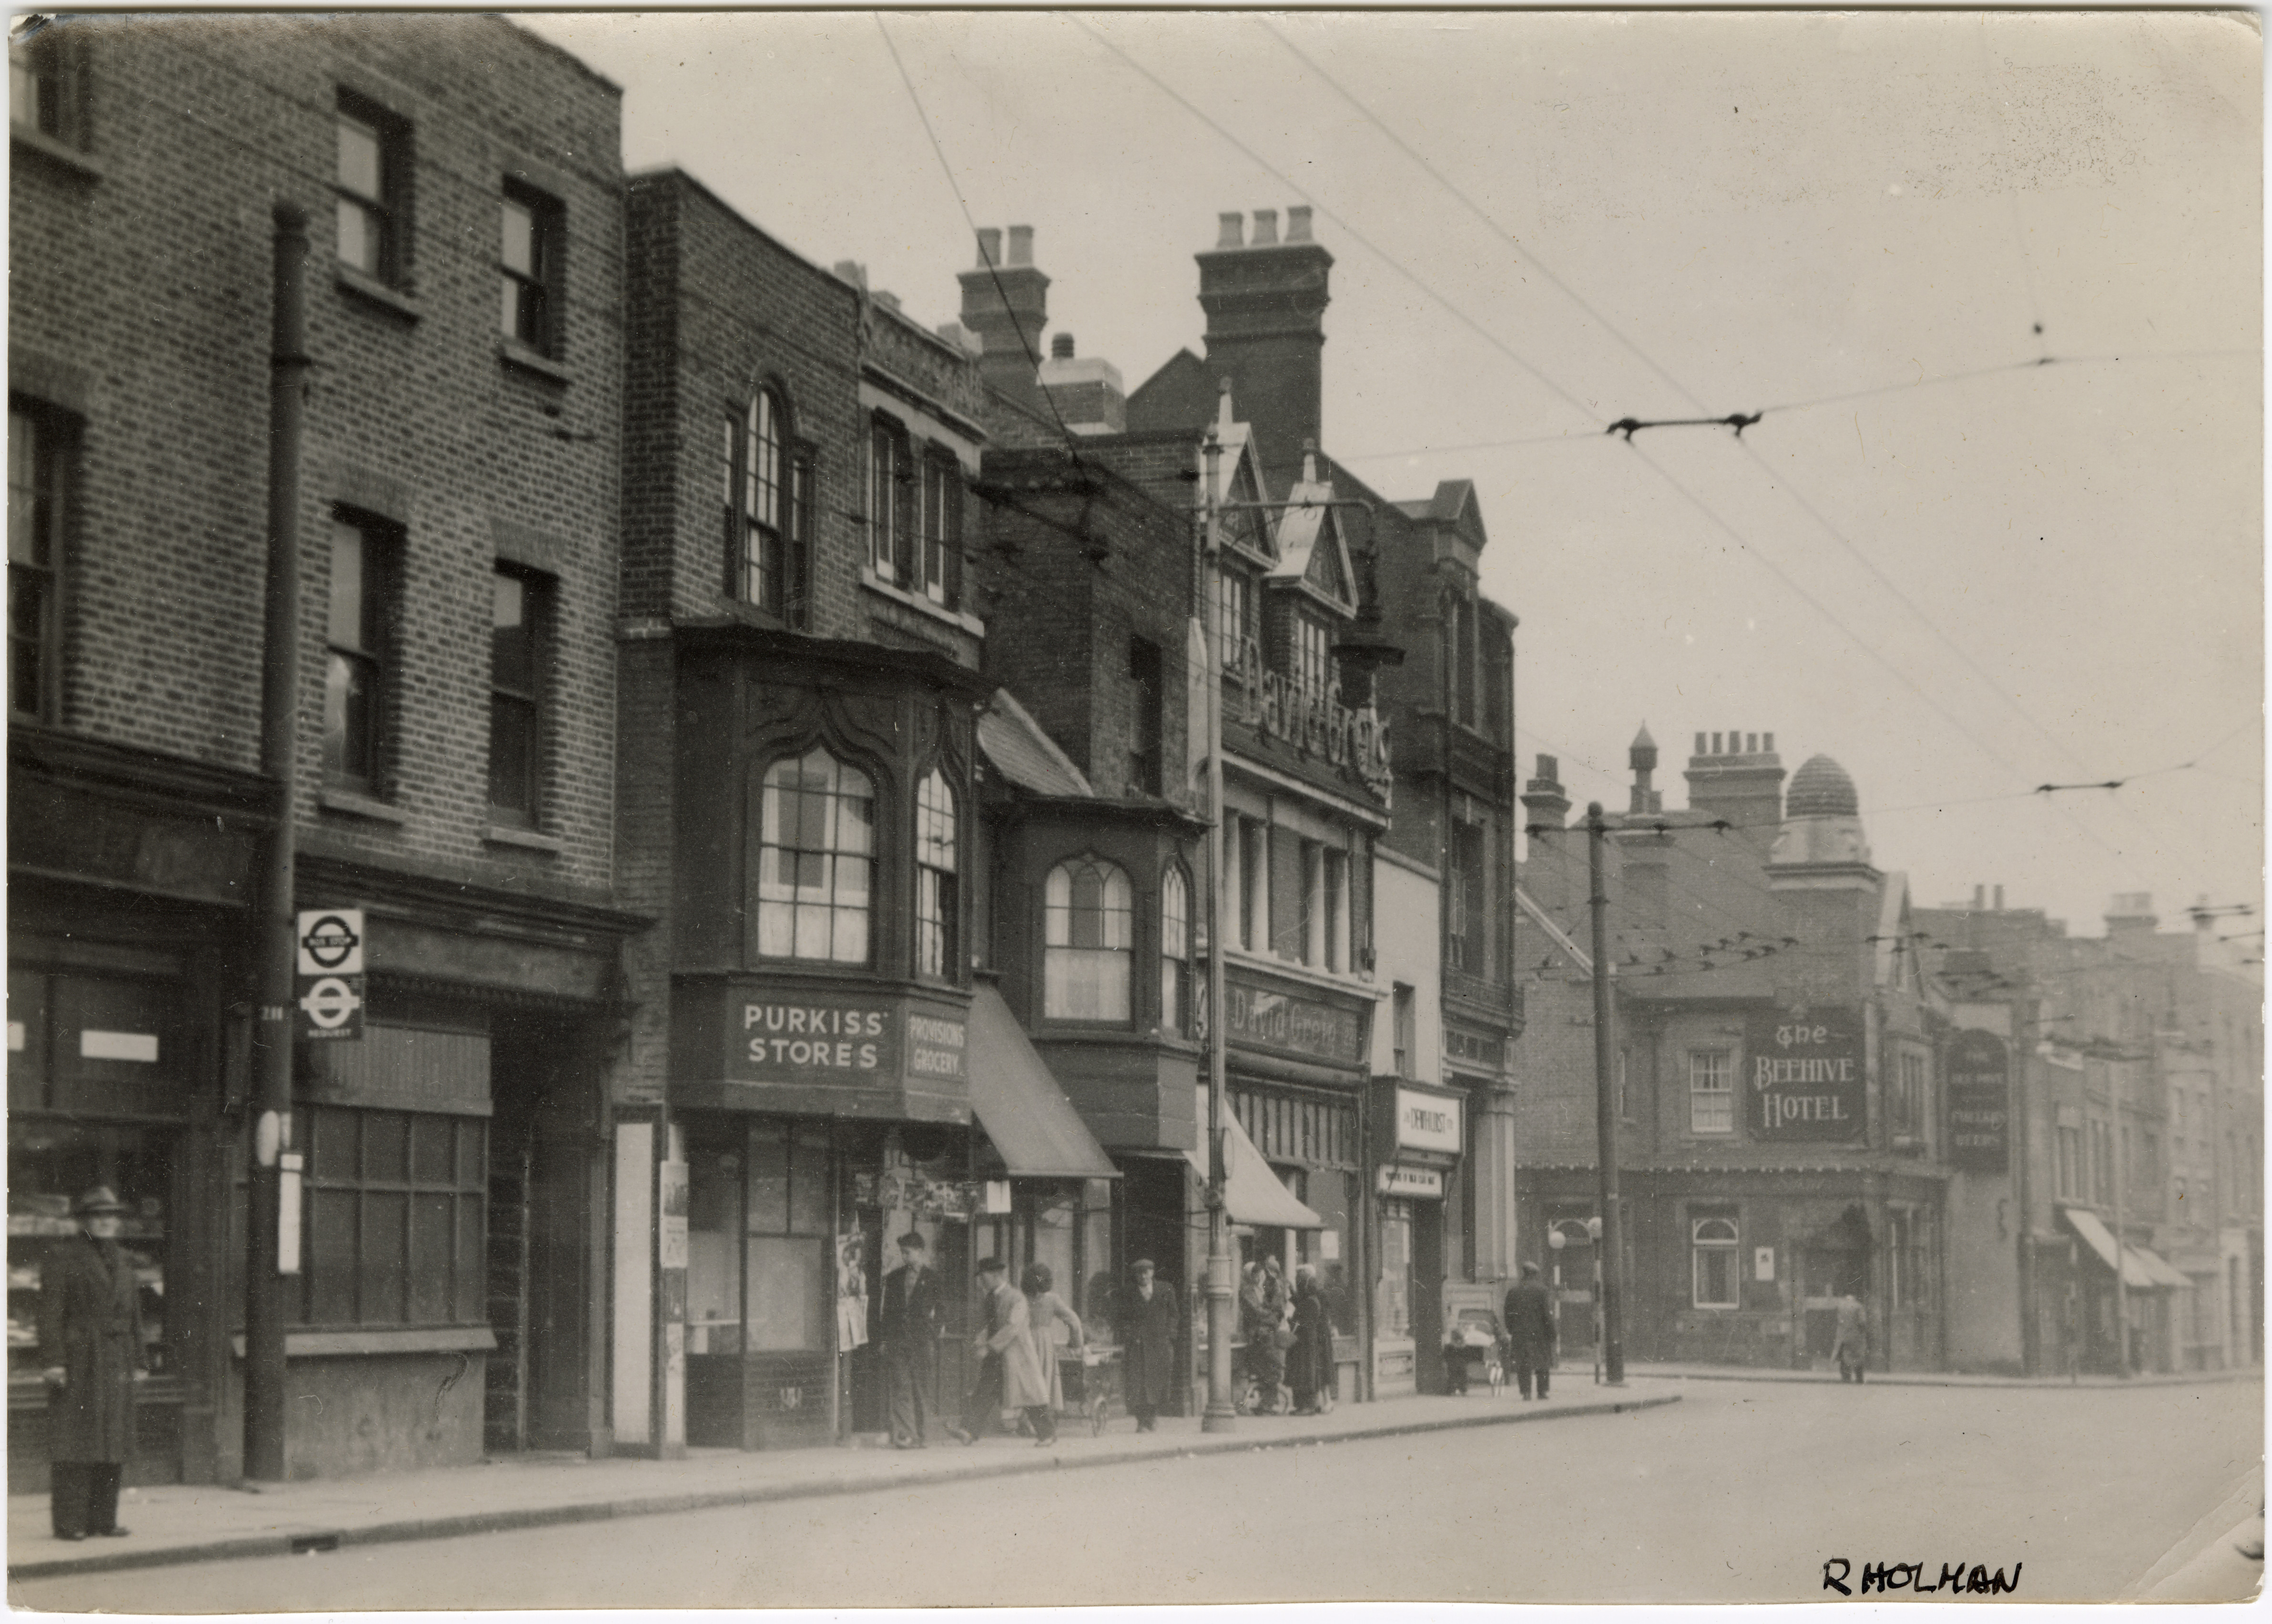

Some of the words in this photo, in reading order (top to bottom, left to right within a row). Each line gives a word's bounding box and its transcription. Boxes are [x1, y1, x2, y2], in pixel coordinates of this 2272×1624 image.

[1234, 989, 1286, 1038] David
[910, 1015, 964, 1048] PROVISIONS
[1776, 1025, 1827, 1049] The
[748, 1037, 877, 1068] STORES
[914, 1048, 959, 1074] GROCERY
[1753, 1056, 1854, 1091] BEEHIVE
[1410, 1108, 1447, 1134] DEWHURST
[1763, 1093, 1849, 1128] HOTEL
